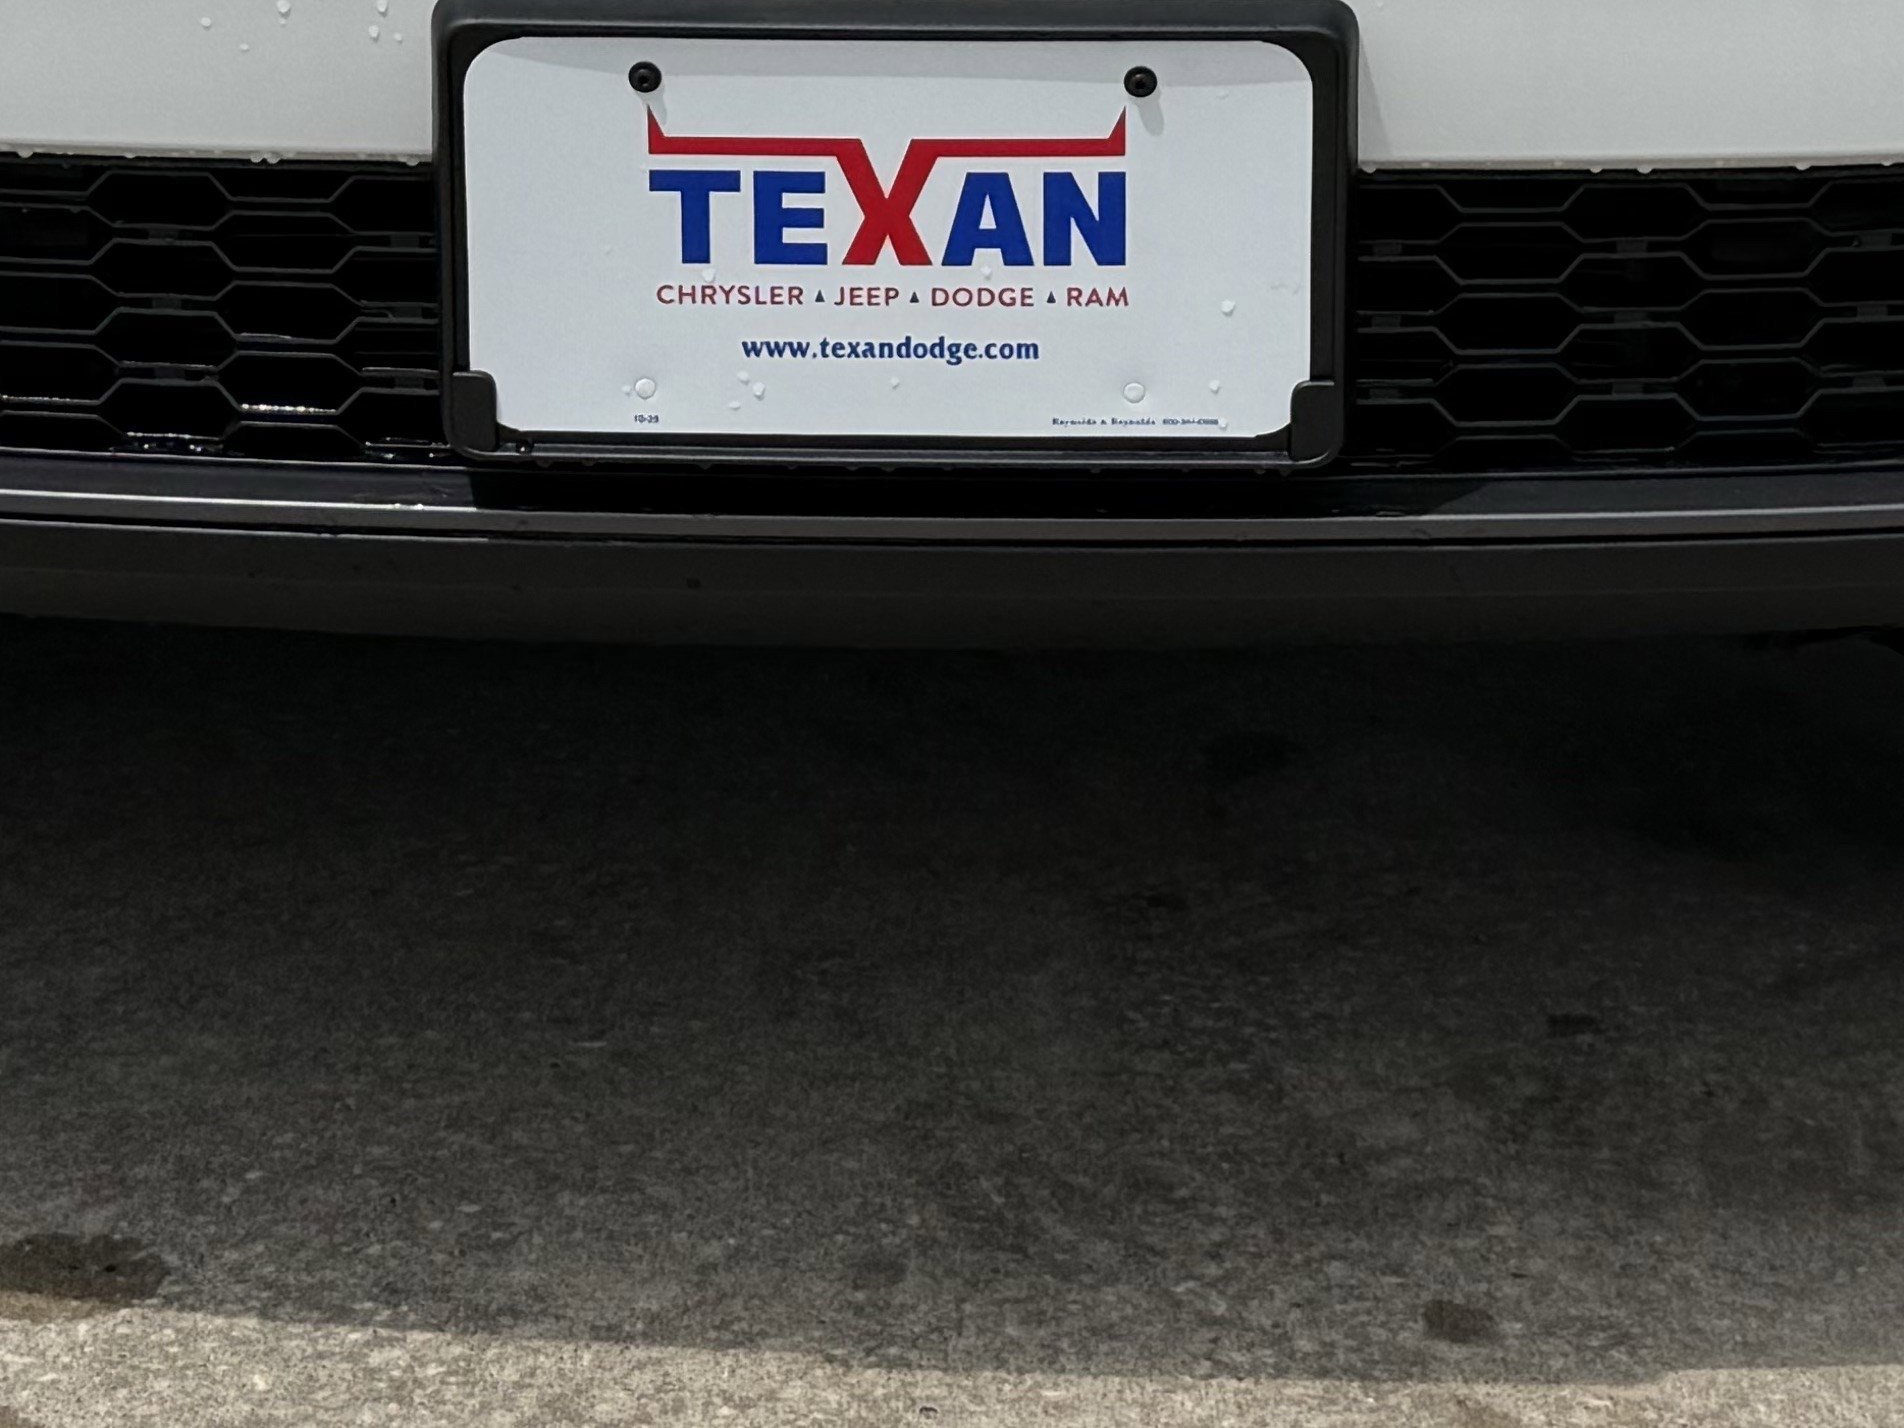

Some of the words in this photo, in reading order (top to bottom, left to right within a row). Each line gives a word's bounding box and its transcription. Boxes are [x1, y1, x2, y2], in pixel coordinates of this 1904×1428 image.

[648, 106, 1127, 267] TEXAN
[656, 285, 804, 306] CHRYSLER
[834, 287, 900, 307] JEEP
[931, 288, 1035, 307] DODGE
[1067, 287, 1129, 307] RAM
[742, 335, 1040, 366] www.texandodge.com
